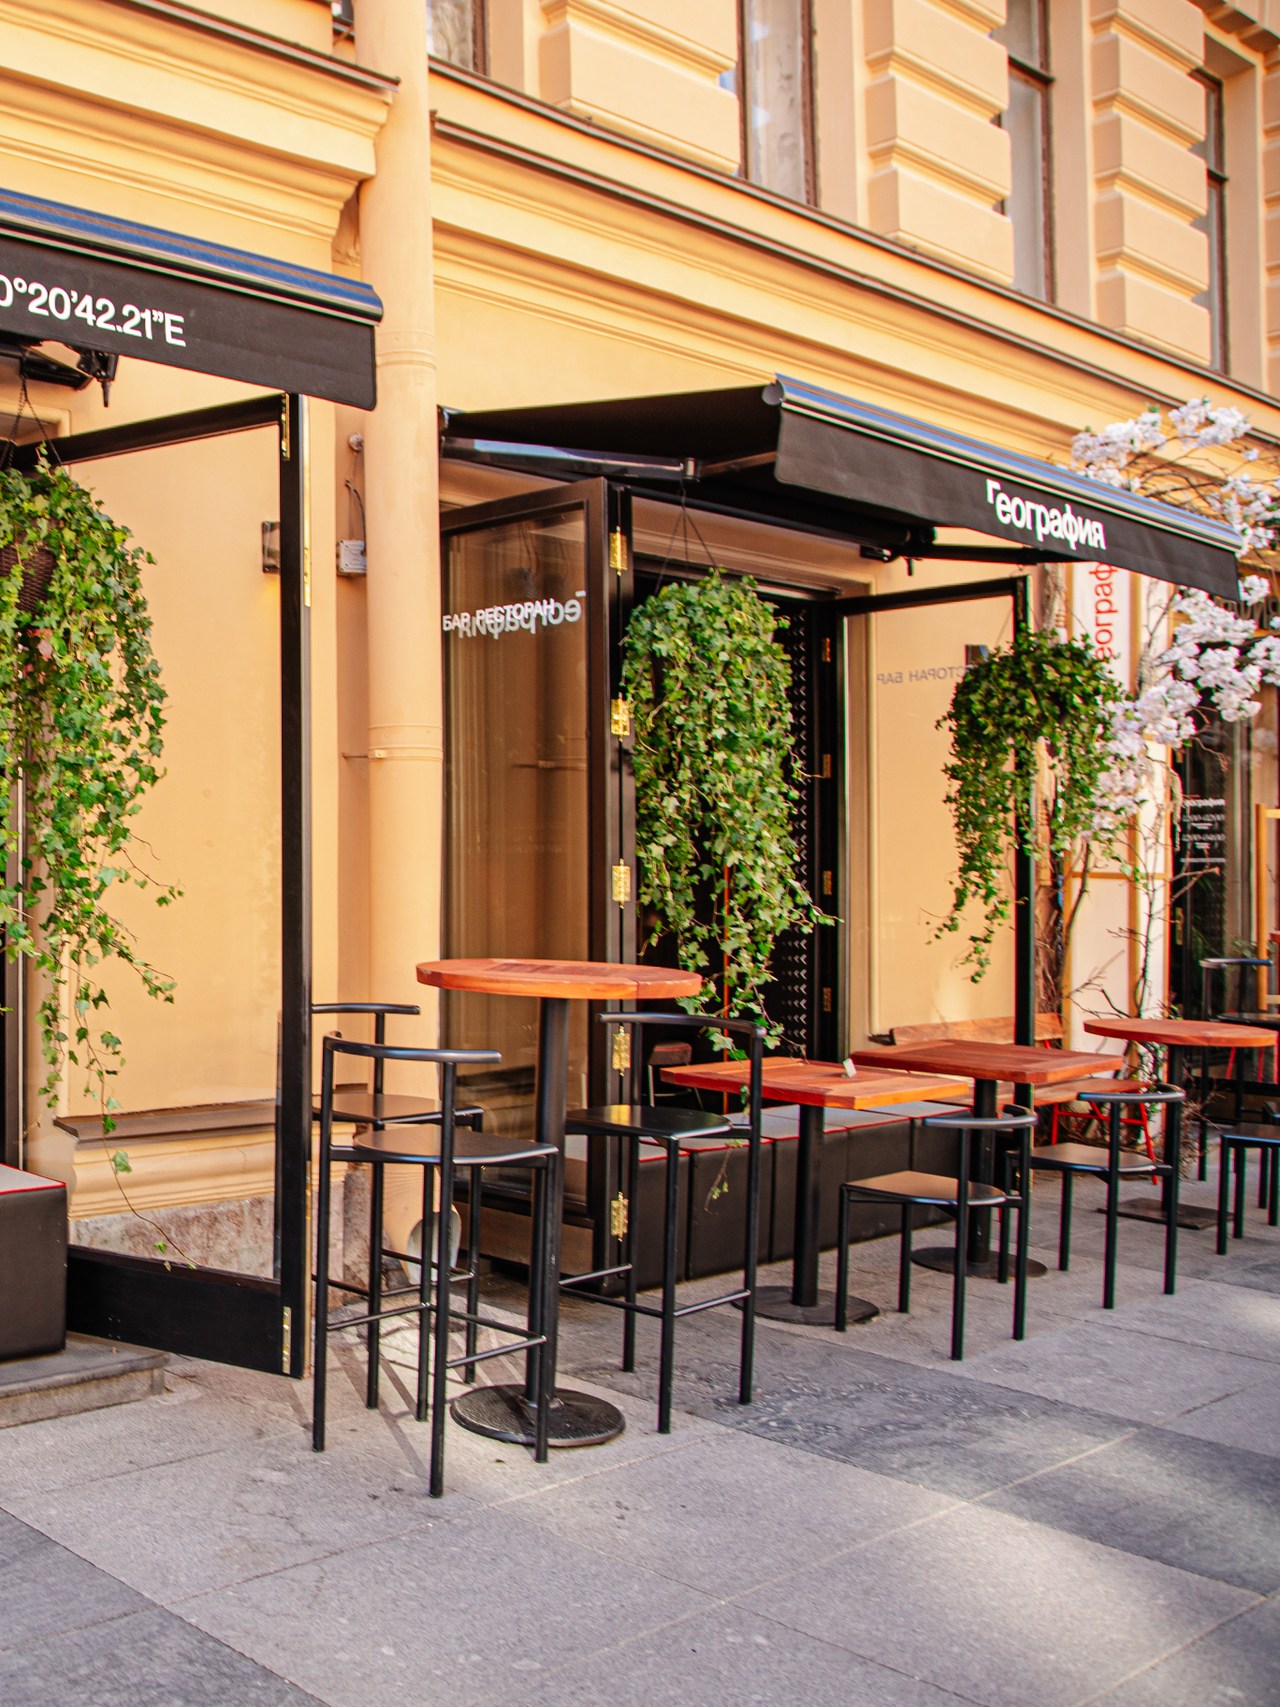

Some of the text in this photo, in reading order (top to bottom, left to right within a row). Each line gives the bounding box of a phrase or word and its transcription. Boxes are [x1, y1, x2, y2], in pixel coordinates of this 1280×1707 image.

[986, 478, 1106, 550] География
[442, 598, 555, 631] БАР РЕСТОРАН
